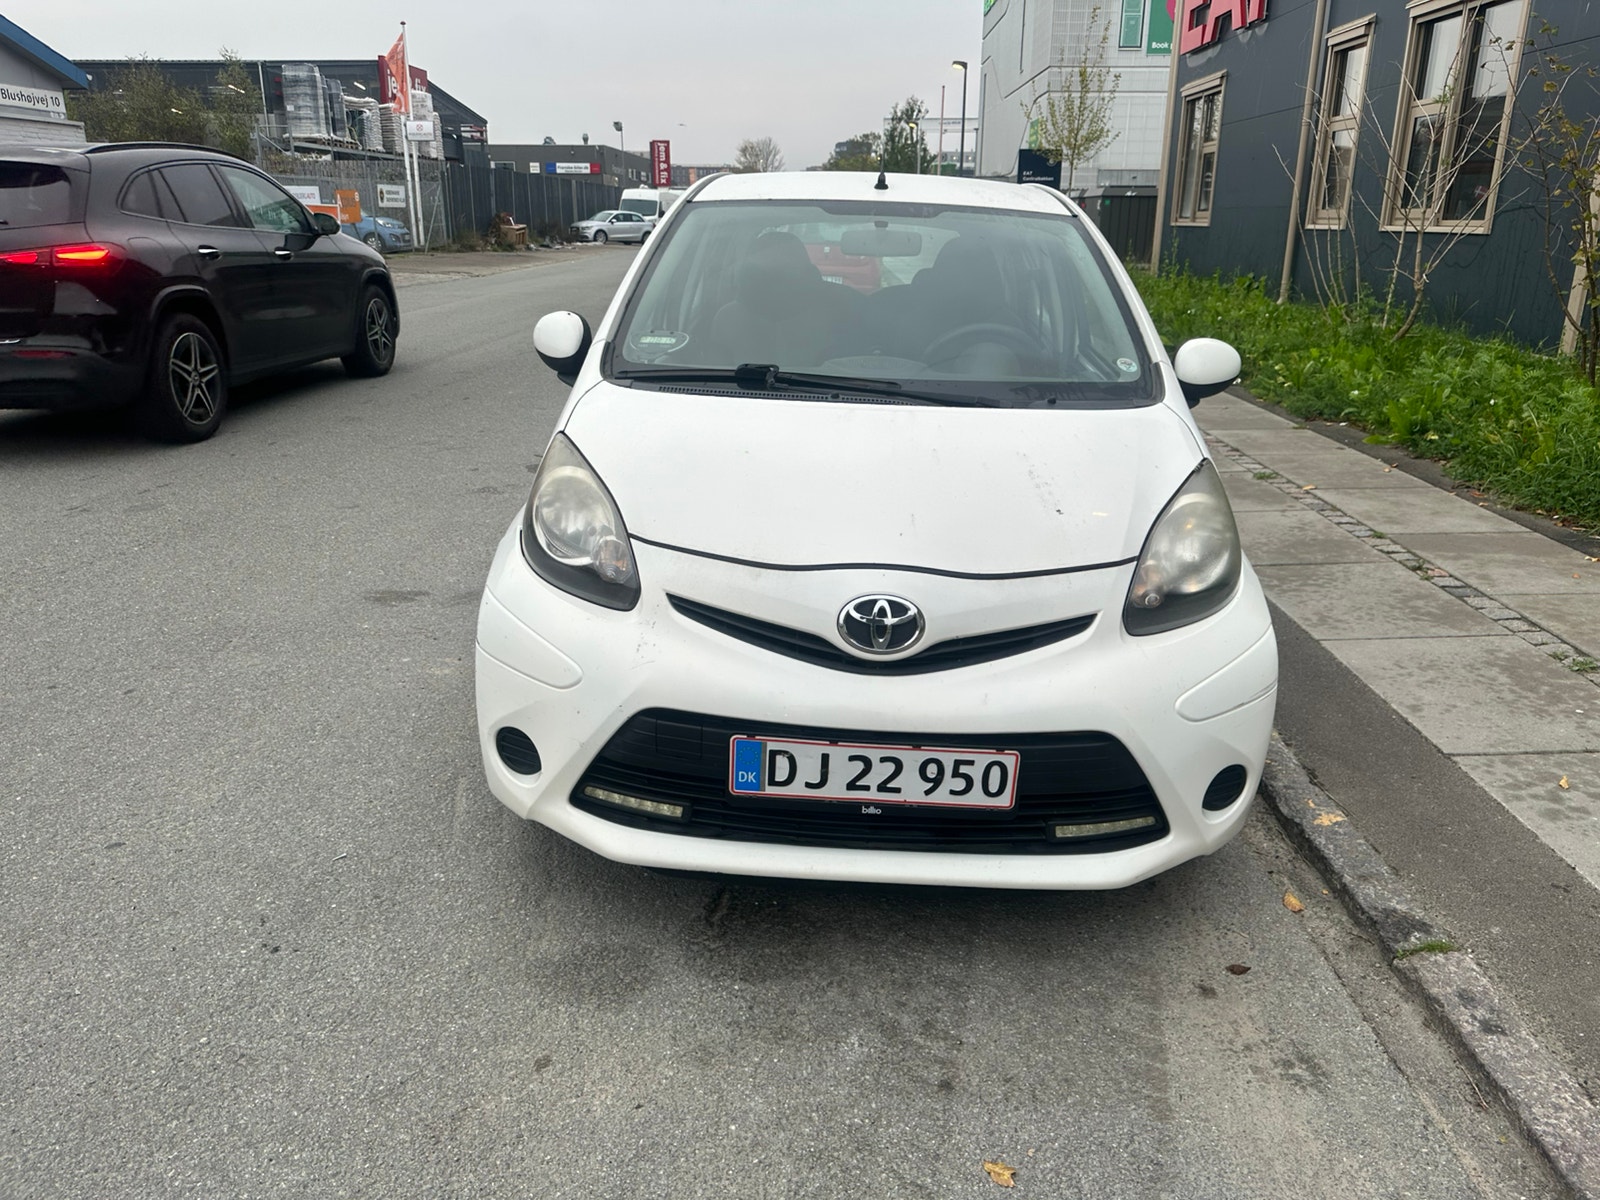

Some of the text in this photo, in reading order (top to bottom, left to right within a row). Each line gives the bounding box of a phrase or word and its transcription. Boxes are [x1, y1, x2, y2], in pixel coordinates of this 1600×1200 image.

[1151, 41, 1169, 49] Book
[0, 88, 61, 108] Blushøjvej 10
[657, 142, 668, 184] jem & fix
[738, 749, 1009, 798] DK DJ 22 950
